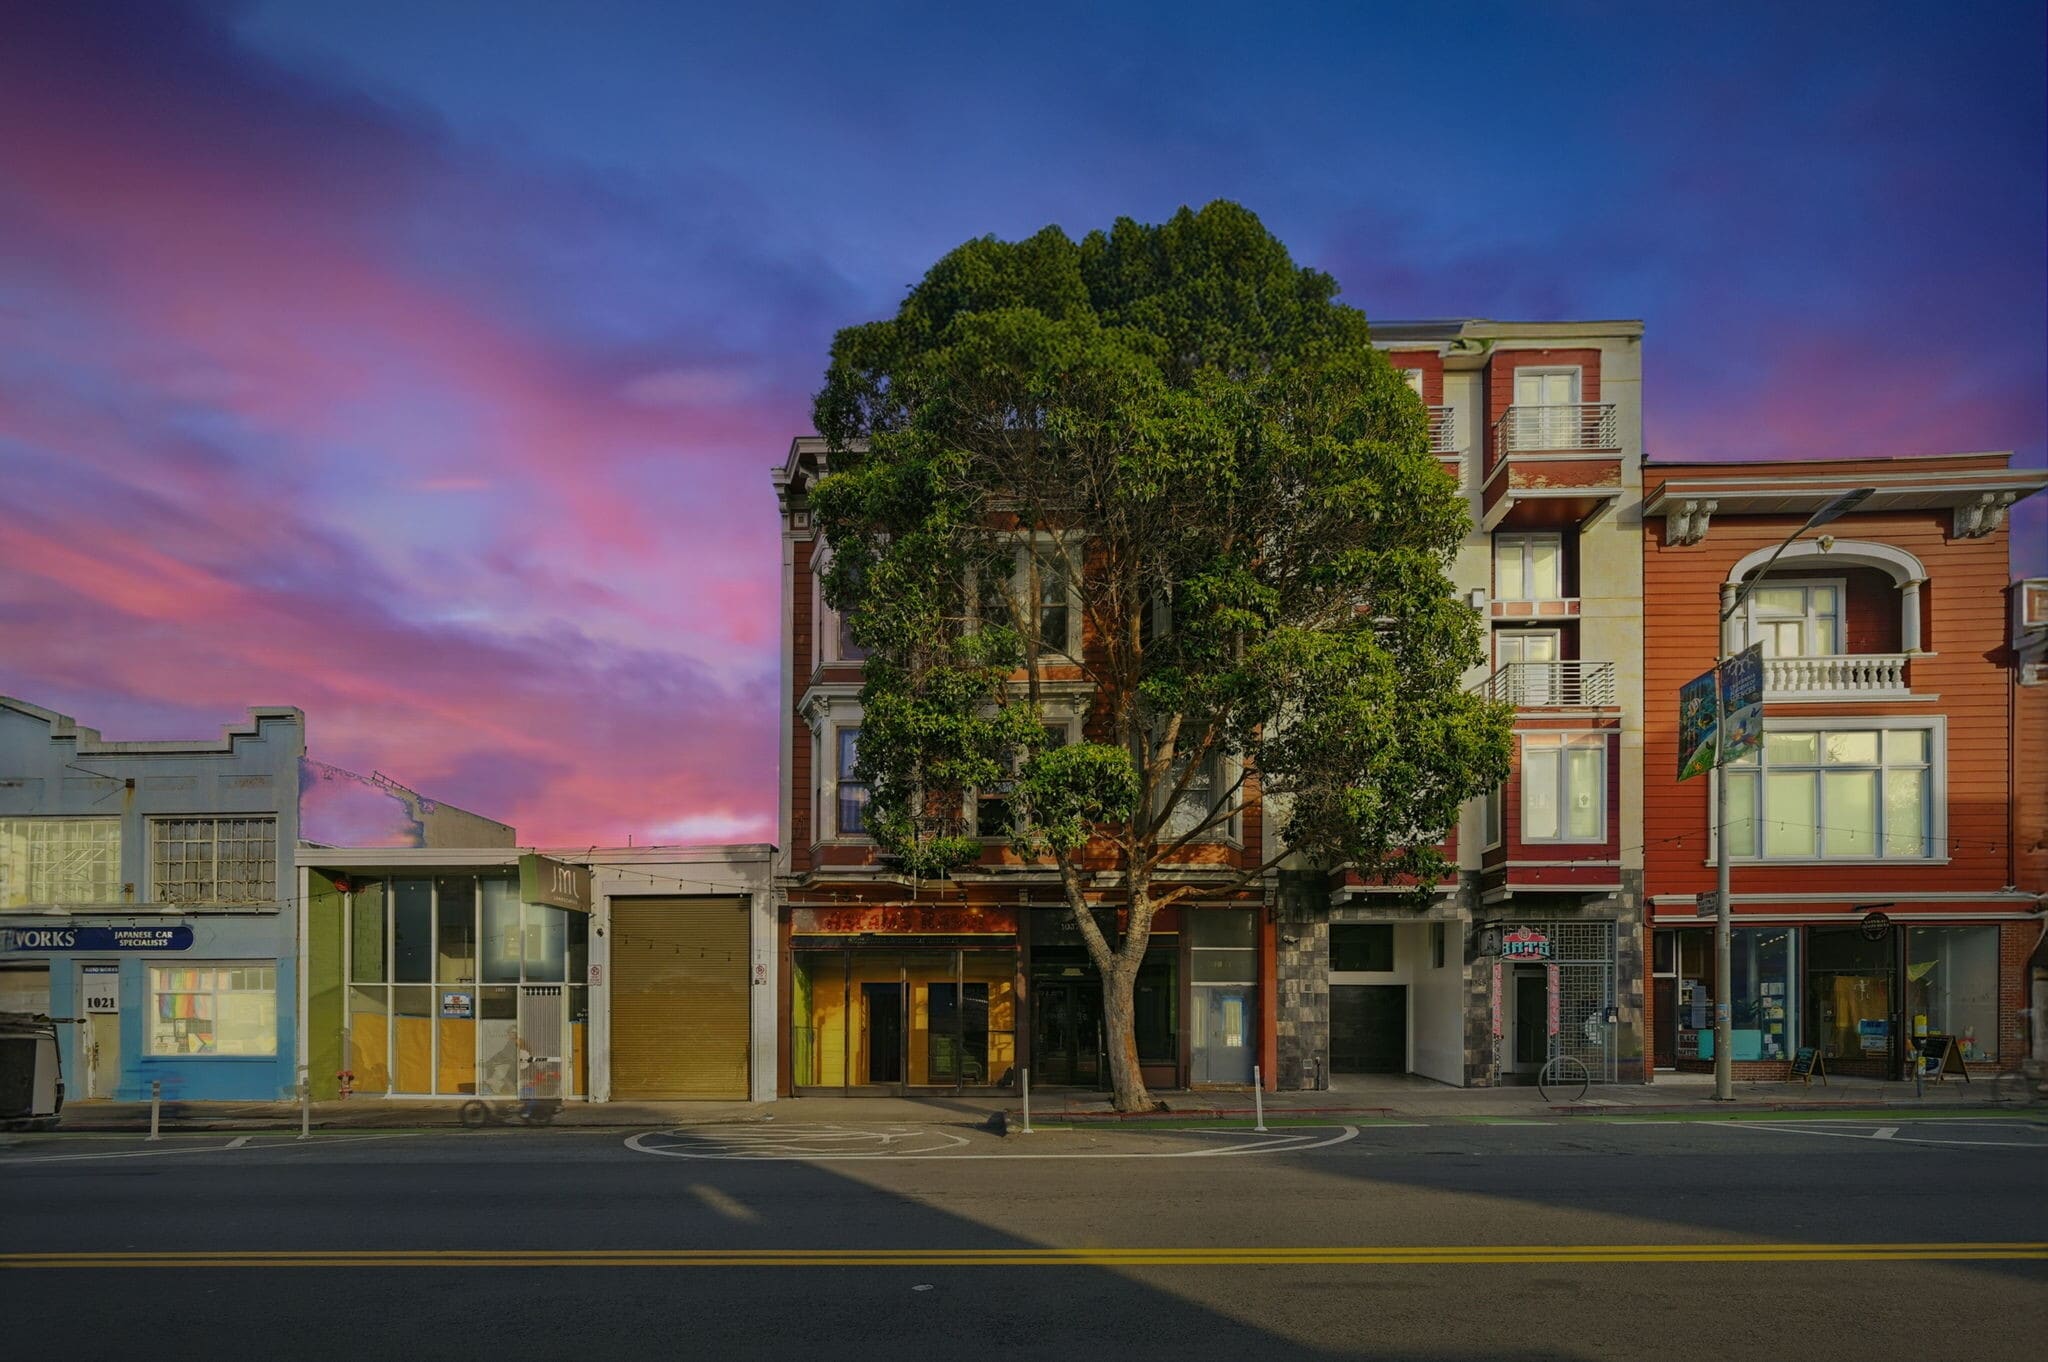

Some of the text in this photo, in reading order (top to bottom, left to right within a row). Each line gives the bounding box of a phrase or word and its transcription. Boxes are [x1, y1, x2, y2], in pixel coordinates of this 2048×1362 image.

[114, 931, 174, 940] JAPANESE CAR
[119, 939, 169, 947] SPECIALISTS
[87, 997, 116, 1009] 1021
